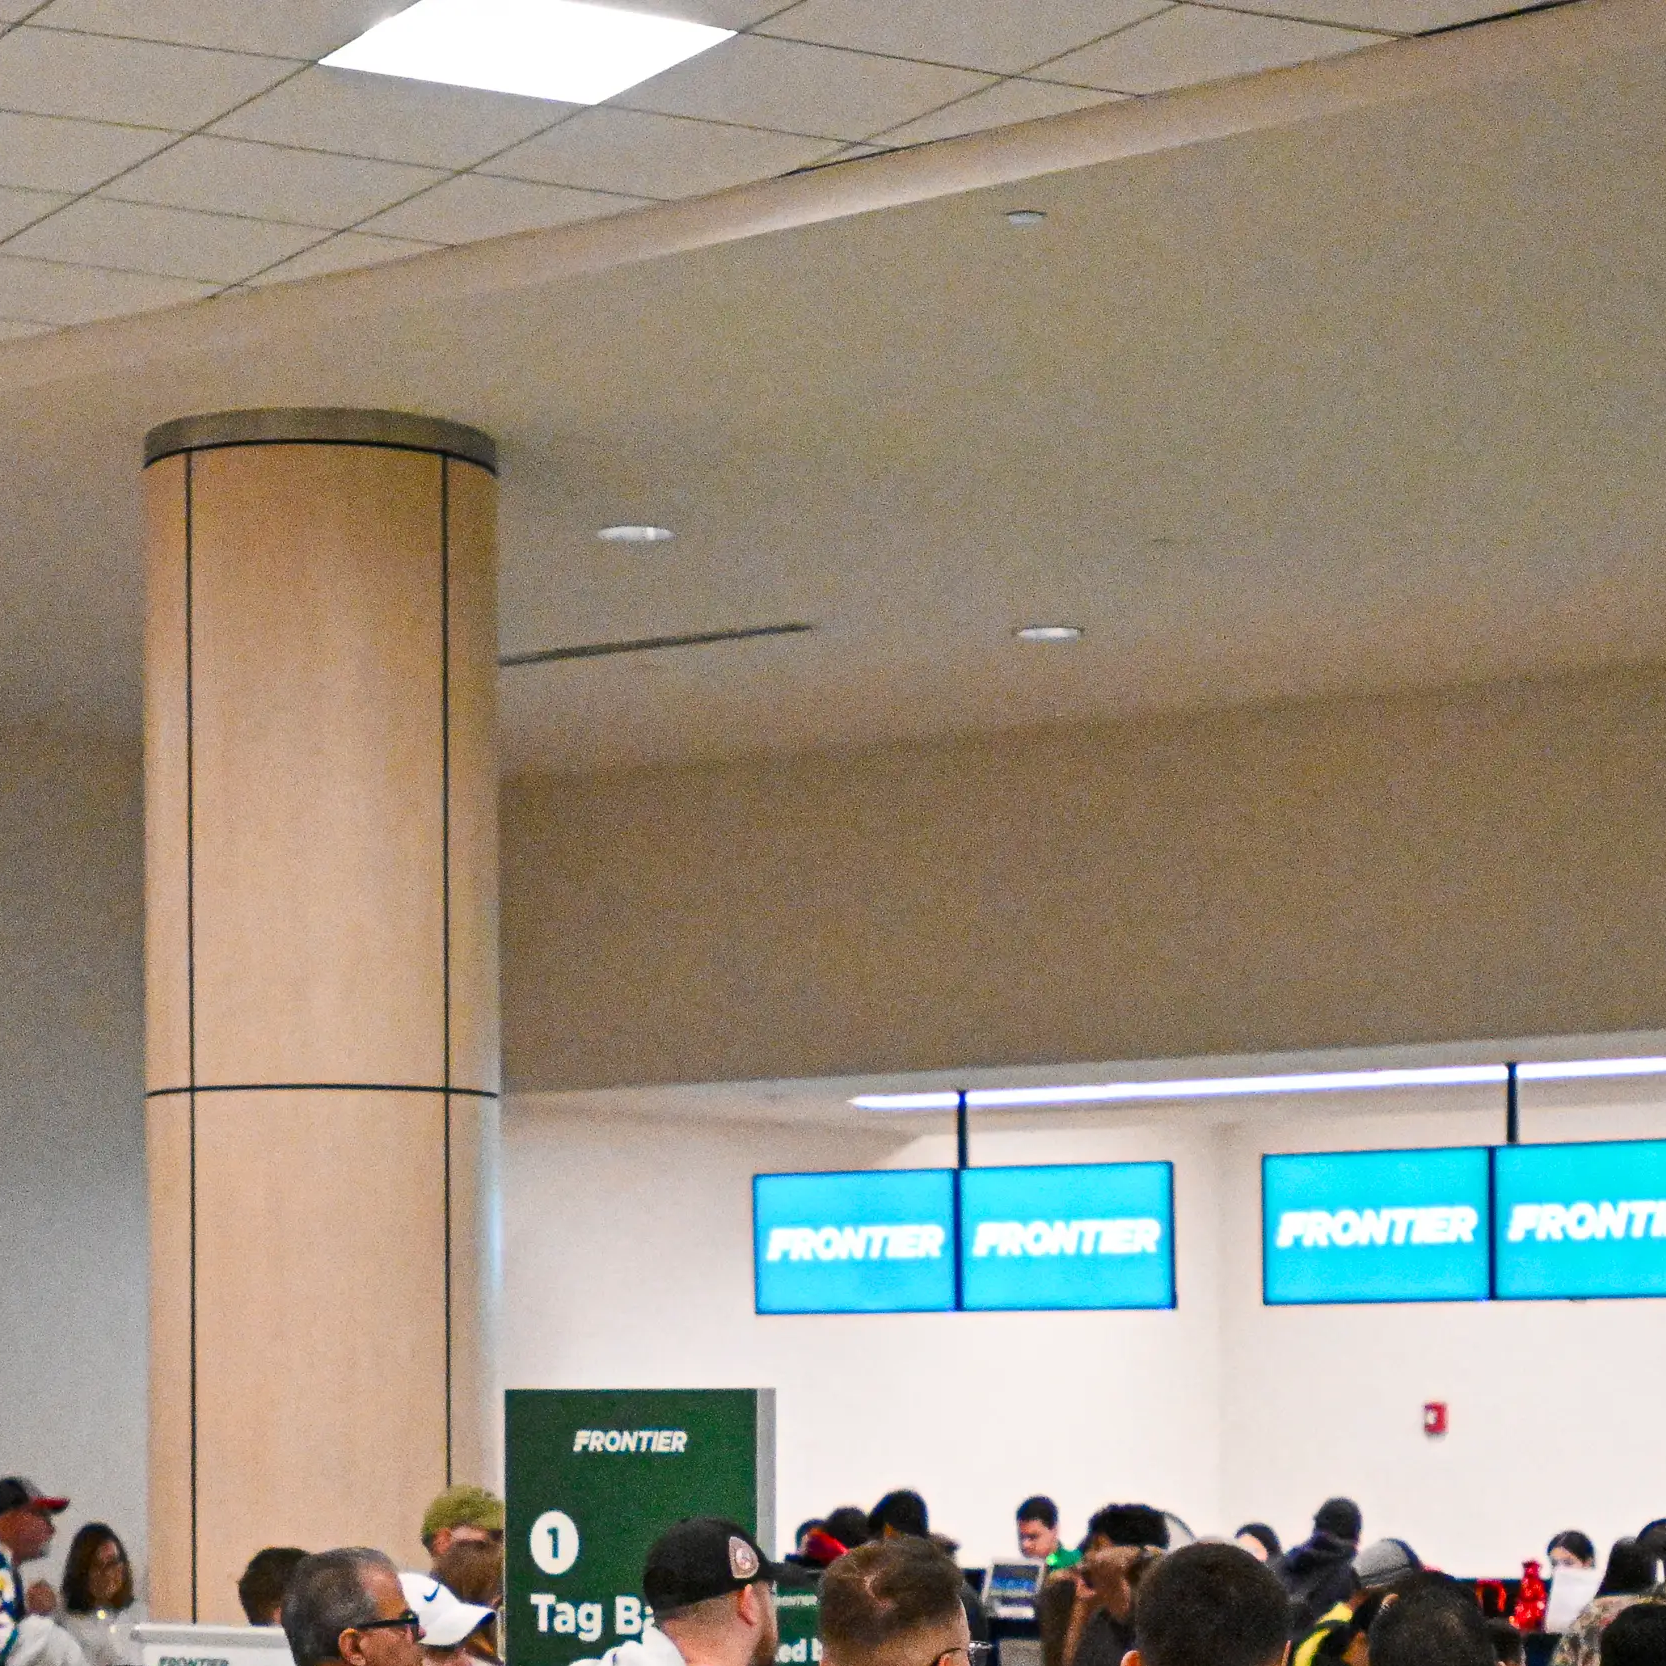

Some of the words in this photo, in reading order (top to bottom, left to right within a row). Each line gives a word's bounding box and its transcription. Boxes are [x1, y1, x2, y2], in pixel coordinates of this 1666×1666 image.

[766, 1224, 945, 1262] FRONTIER
[973, 1218, 1161, 1257] FRONTIER
[1276, 1206, 1478, 1247] FRONTIER
[573, 1429, 688, 1453] FRONTIER
[546, 1526, 560, 1559] 1
[530, 1593, 603, 1642] Tag
